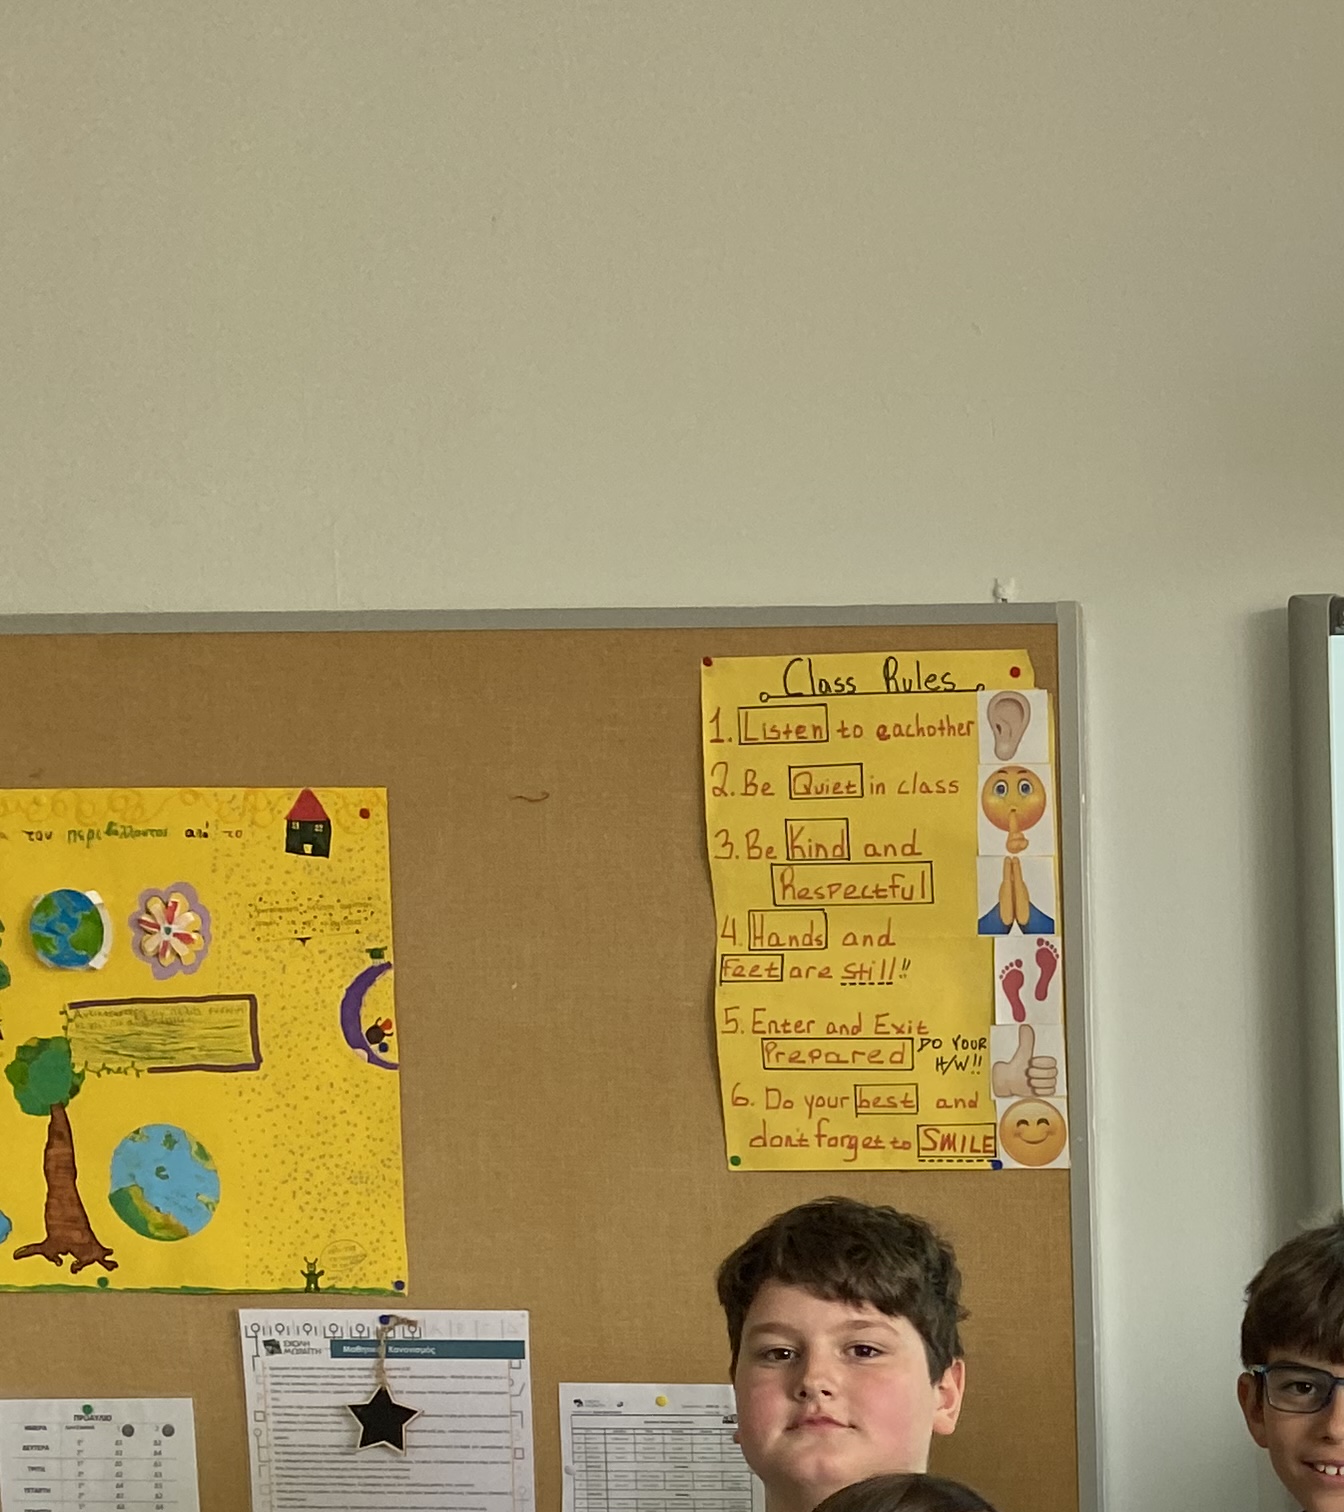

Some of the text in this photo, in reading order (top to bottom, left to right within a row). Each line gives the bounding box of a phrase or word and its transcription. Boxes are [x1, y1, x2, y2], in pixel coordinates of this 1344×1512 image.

[784, 656, 956, 696] Class Rules
[743, 711, 824, 740] Listen
[837, 713, 863, 739] to
[876, 710, 973, 739] eachother
[744, 780, 774, 796] Be
[793, 770, 858, 797] Quiet
[870, 777, 885, 795] in
[897, 770, 959, 795] class
[746, 829, 777, 859] Be
[788, 825, 848, 858] Kind
[865, 829, 921, 857] and
[781, 866, 928, 899] Respectful
[752, 918, 825, 947] Hands
[842, 917, 896, 946] and
[722, 959, 781, 979] Feet
[789, 965, 833, 979] are
[751, 1009, 815, 1034] Enter
[826, 1007, 862, 1035] and
[874, 1011, 929, 1035] Exit
[764, 1043, 906, 1066] Prepared
[918, 1036, 988, 1052] DO YOUR
[765, 1088, 795, 1109] Do
[804, 1093, 850, 1121] your
[857, 1086, 916, 1110] best
[935, 1090, 978, 1110] and
[814, 1118, 885, 1162] forget
[890, 1136, 912, 1149] to
[921, 1128, 996, 1153] SMILE
